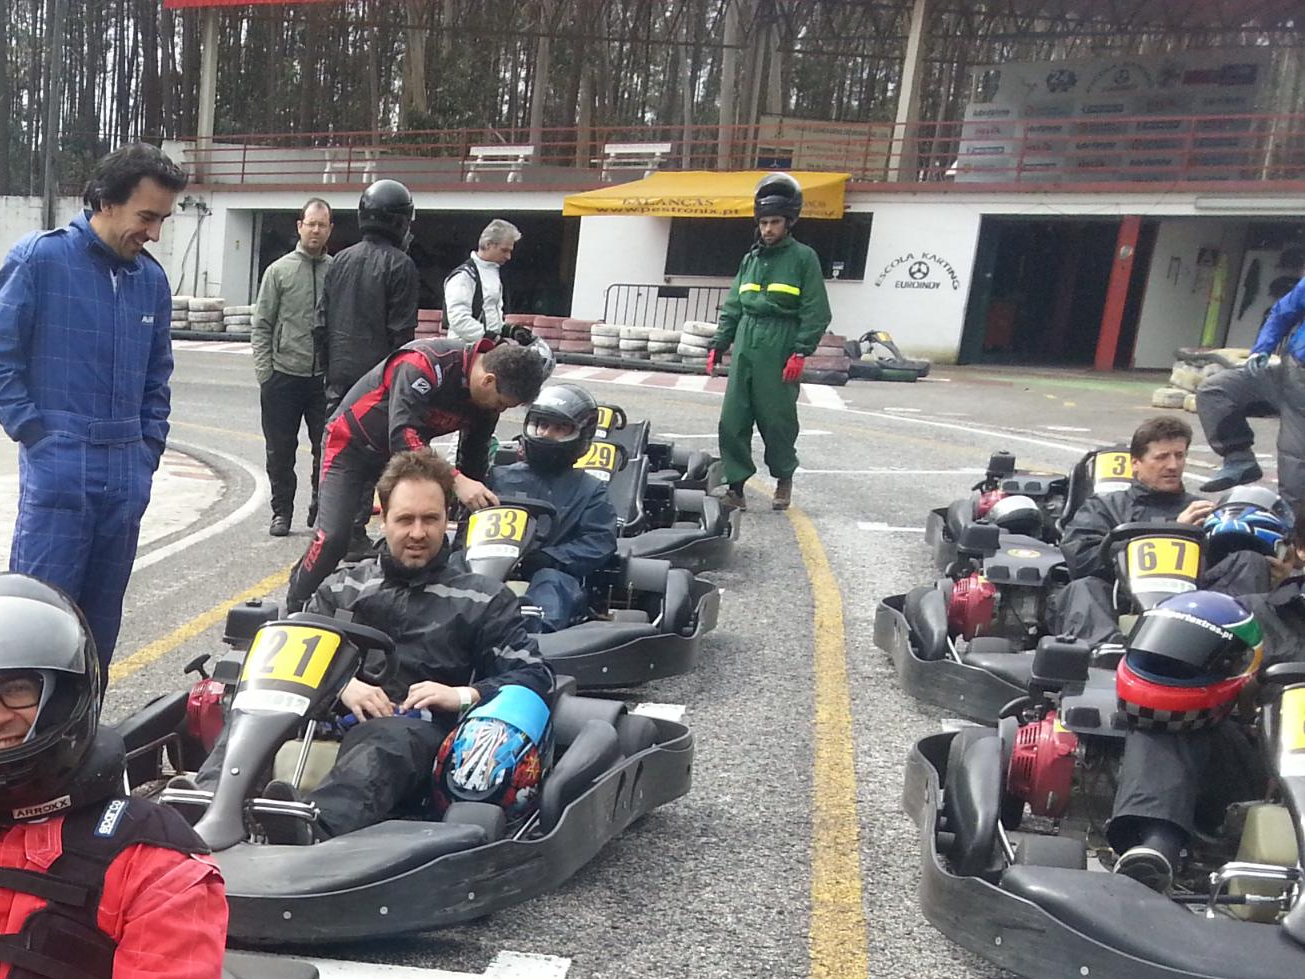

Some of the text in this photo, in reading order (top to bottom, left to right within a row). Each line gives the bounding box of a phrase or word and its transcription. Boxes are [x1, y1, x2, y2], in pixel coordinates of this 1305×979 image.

[875, 251, 959, 290] ESCOLA KARTING
[894, 280, 941, 289] EUROINDY
[585, 444, 611, 467] 29
[1112, 455, 1127, 476] 3
[485, 510, 518, 539] 33
[1137, 541, 1186, 571] 67
[260, 630, 322, 678] 21
[17, 799, 67, 817] ARROXX
[98, 800, 122, 834] sparco
